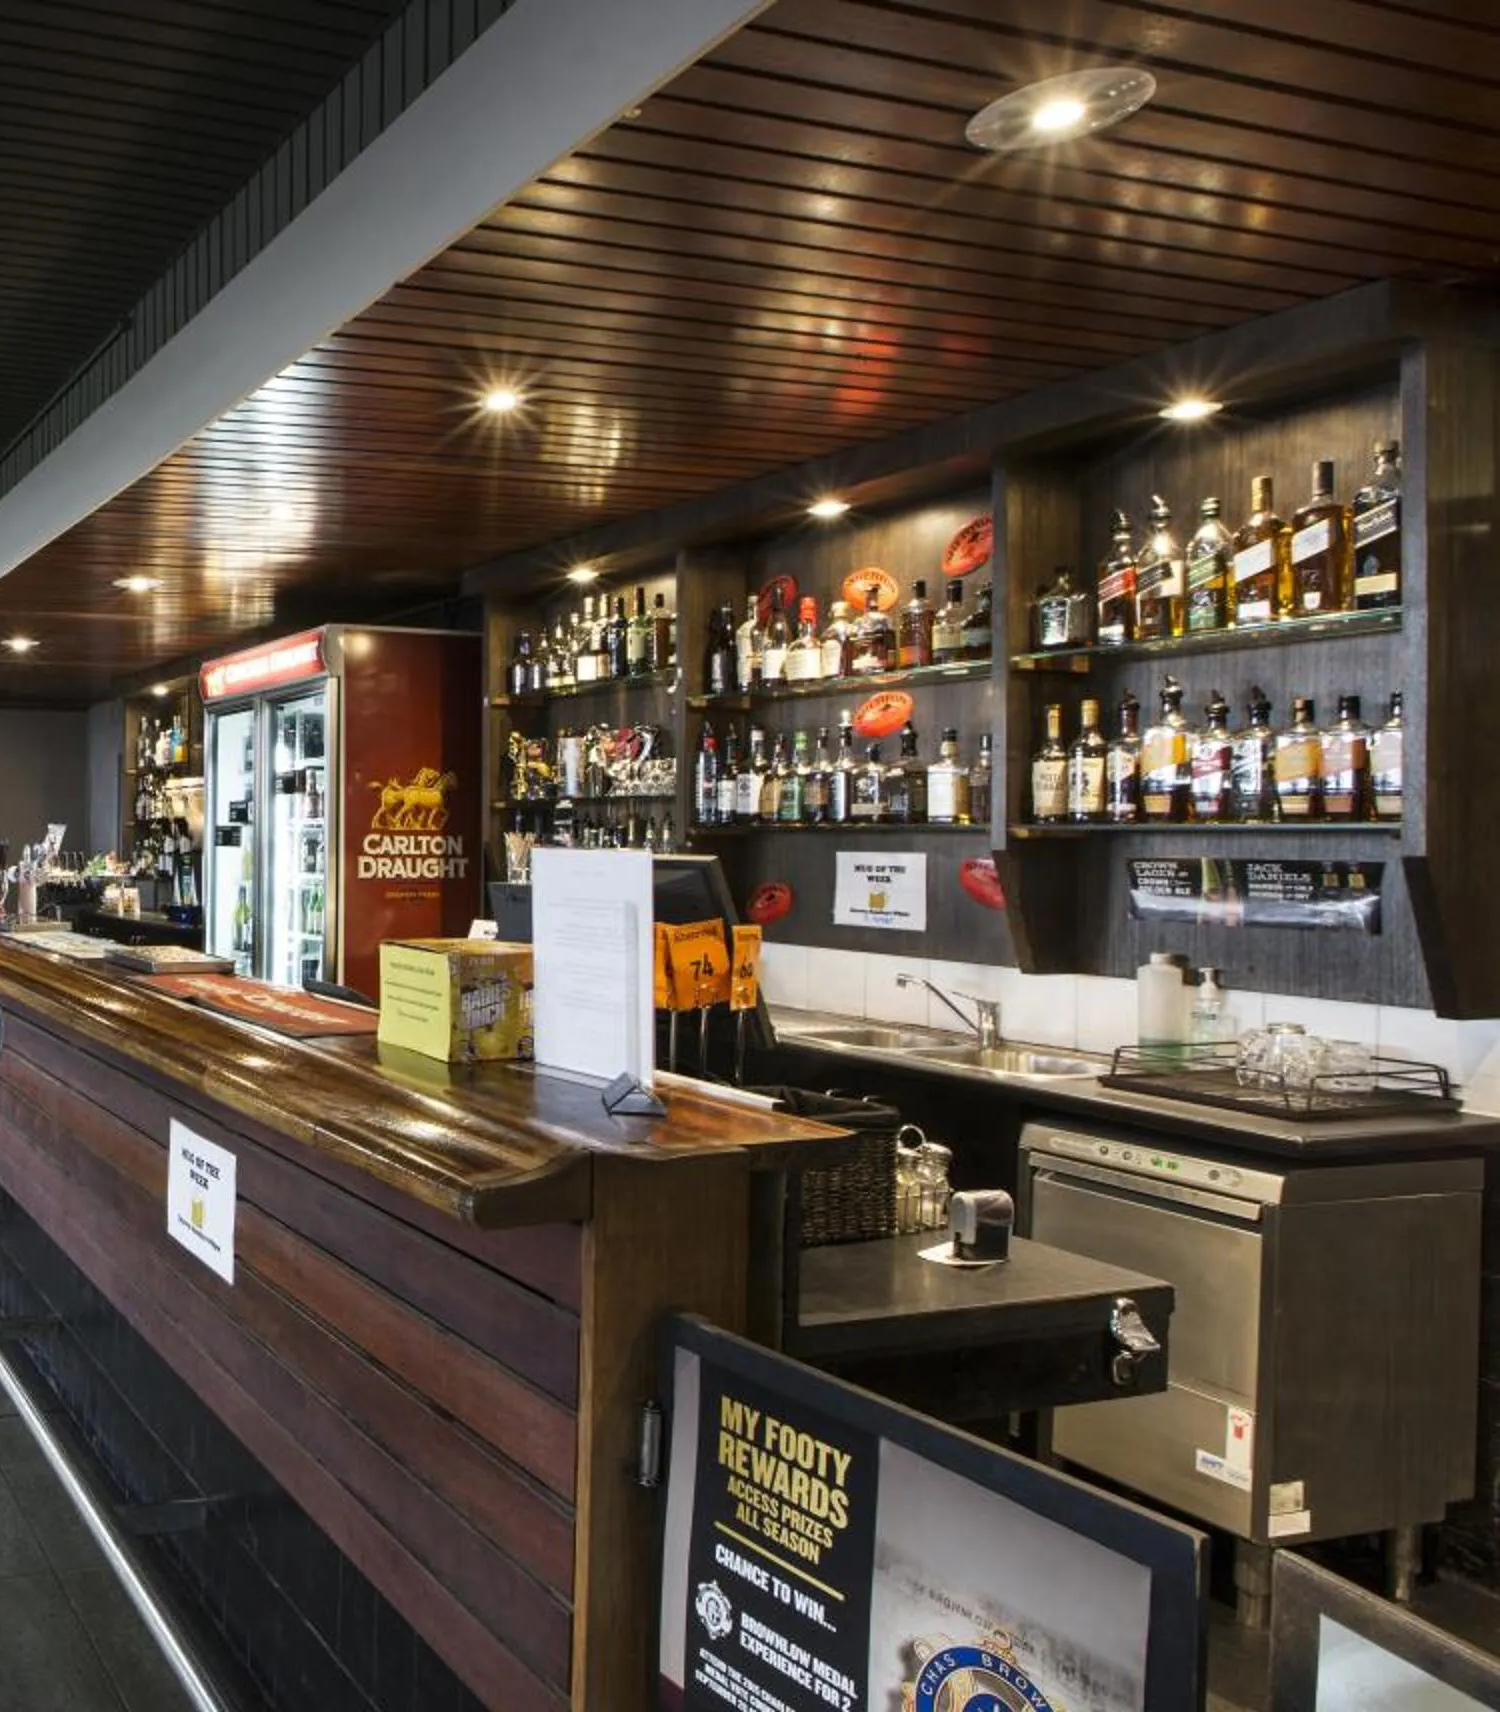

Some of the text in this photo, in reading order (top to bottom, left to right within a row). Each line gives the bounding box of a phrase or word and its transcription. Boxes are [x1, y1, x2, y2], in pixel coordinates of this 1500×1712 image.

[357, 855, 469, 879] DRAUGHT
[363, 833, 463, 855] CARLTON
[721, 1395, 852, 1487] MY FOOTY
[718, 1430, 850, 1529] REWARDS
[727, 1475, 833, 1549] ACCESS PRIZES
[736, 1502, 820, 1565] ALL SEASON
[715, 1543, 769, 1592] CHANCE
[772, 1577, 791, 1604] TO
[740, 1631, 852, 1712] EXPERIENCE FOR 2
[741, 1611, 859, 1700] BROWNLOW MEDAL
[920, 1653, 956, 1695] CHAS
